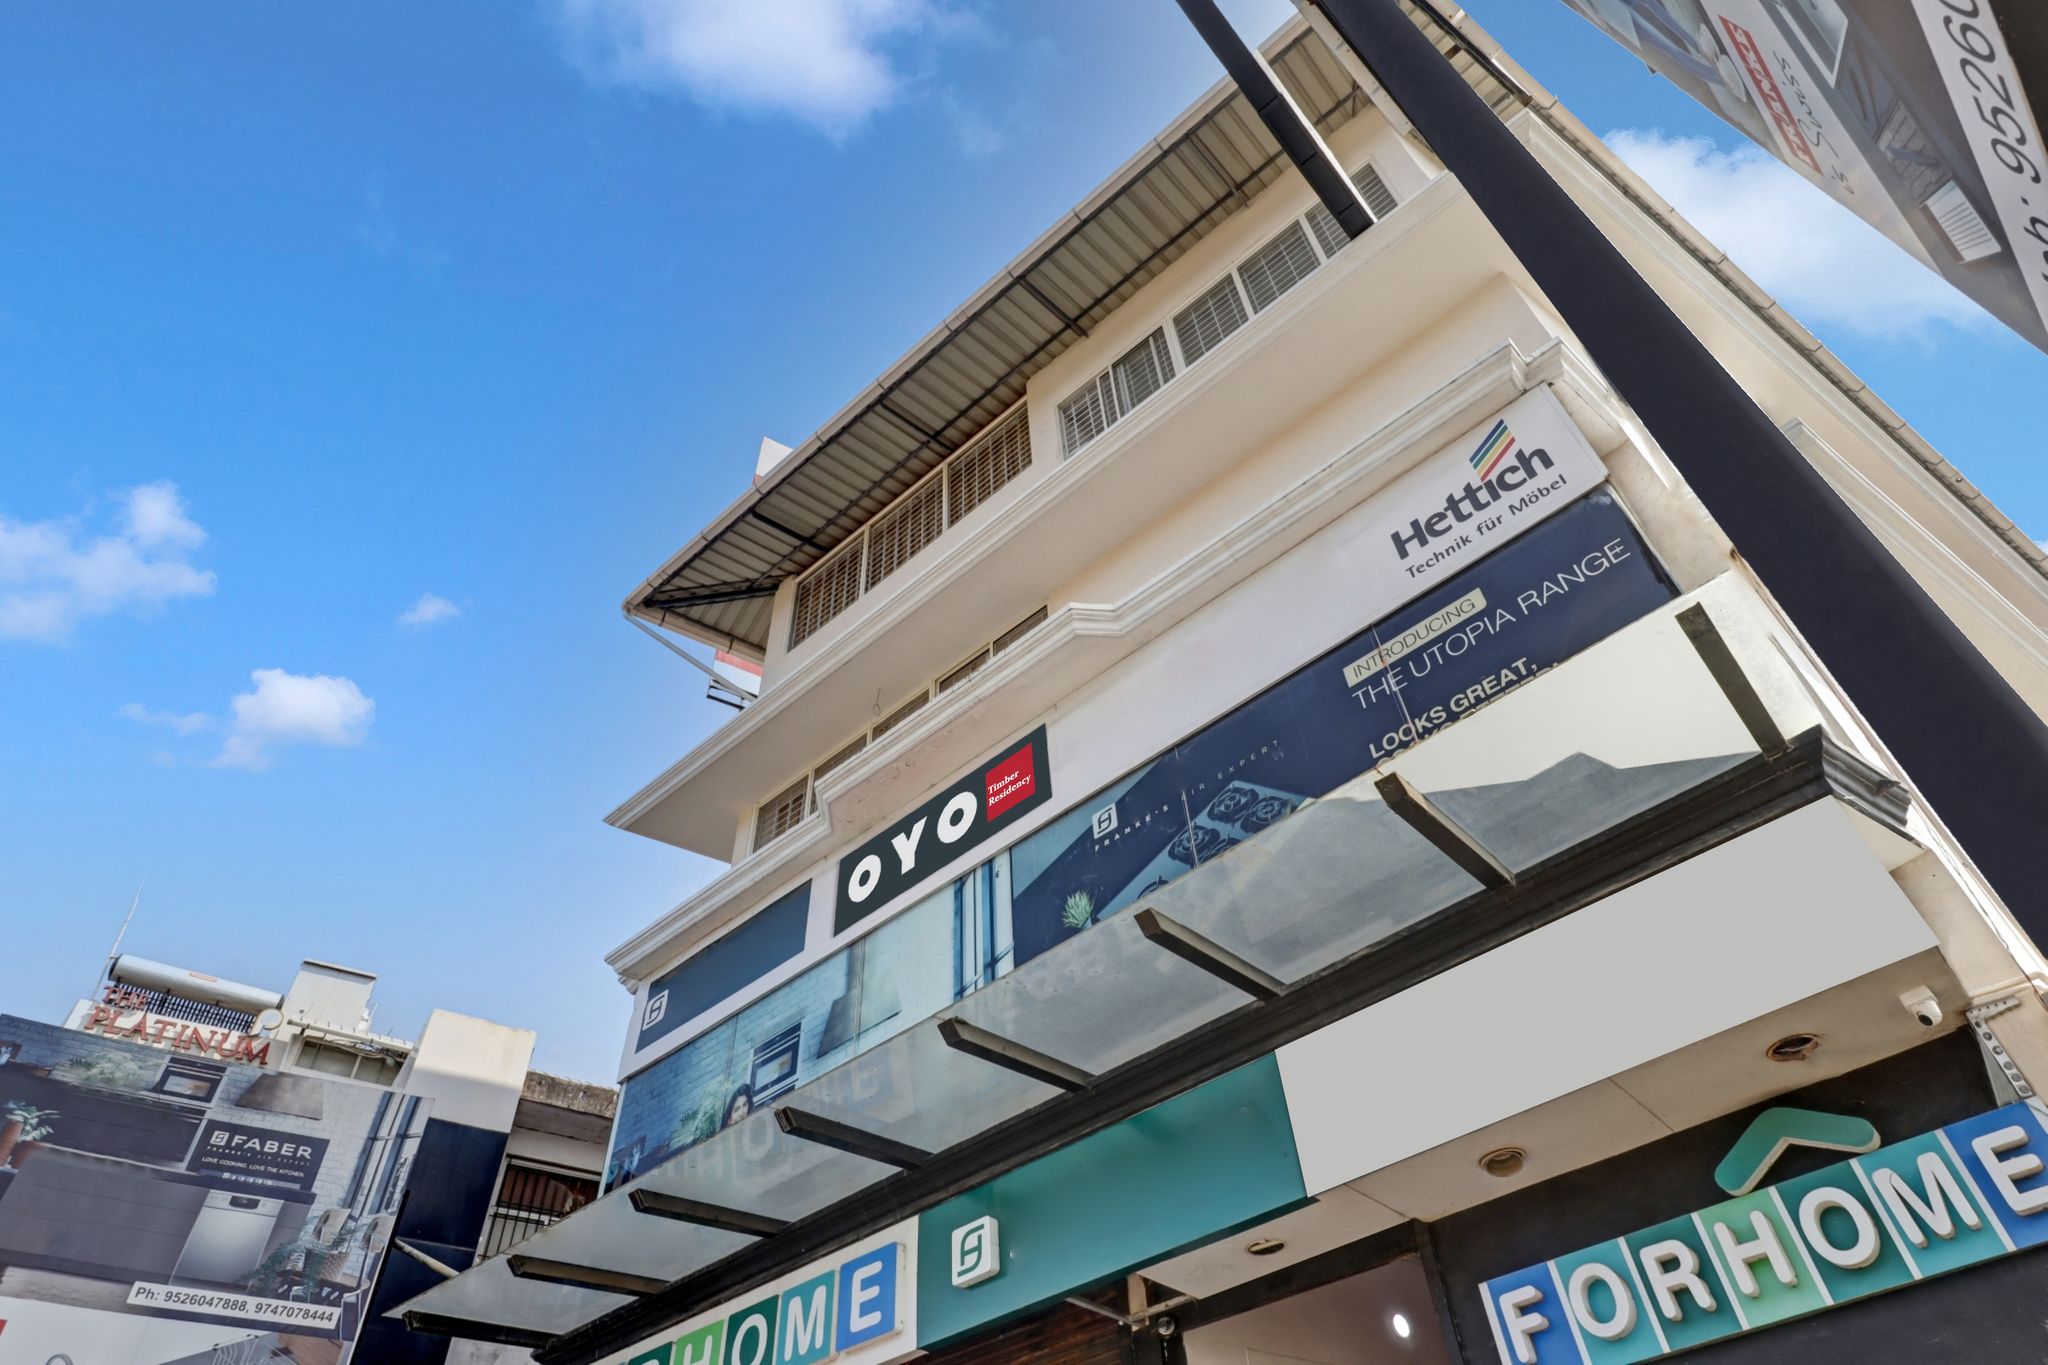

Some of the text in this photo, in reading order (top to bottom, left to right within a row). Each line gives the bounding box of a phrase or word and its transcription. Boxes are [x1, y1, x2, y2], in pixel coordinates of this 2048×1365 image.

[1390, 448, 1555, 561] Hettich
[1405, 473, 1568, 578] Technik für Möbel
[1351, 538, 1632, 710] THE UTOPIA RANGE
[1351, 597, 1477, 679] INTRODUCING
[1368, 705, 1448, 760] LOOKS
[1449, 656, 1539, 713] GREAT,
[987, 770, 1020, 795] Timber
[988, 774, 1032, 807] Residency
[1217, 739, 1279, 780] EXPERT
[847, 790, 979, 904] OYO
[103, 985, 151, 1010] THE
[84, 1005, 272, 1065] PLATINUM
[231, 1134, 313, 1160] FABER
[1500, 1124, 2048, 1364] FORHOME
[134, 1286, 334, 1323] Ph: 9526047888, 9747078444
